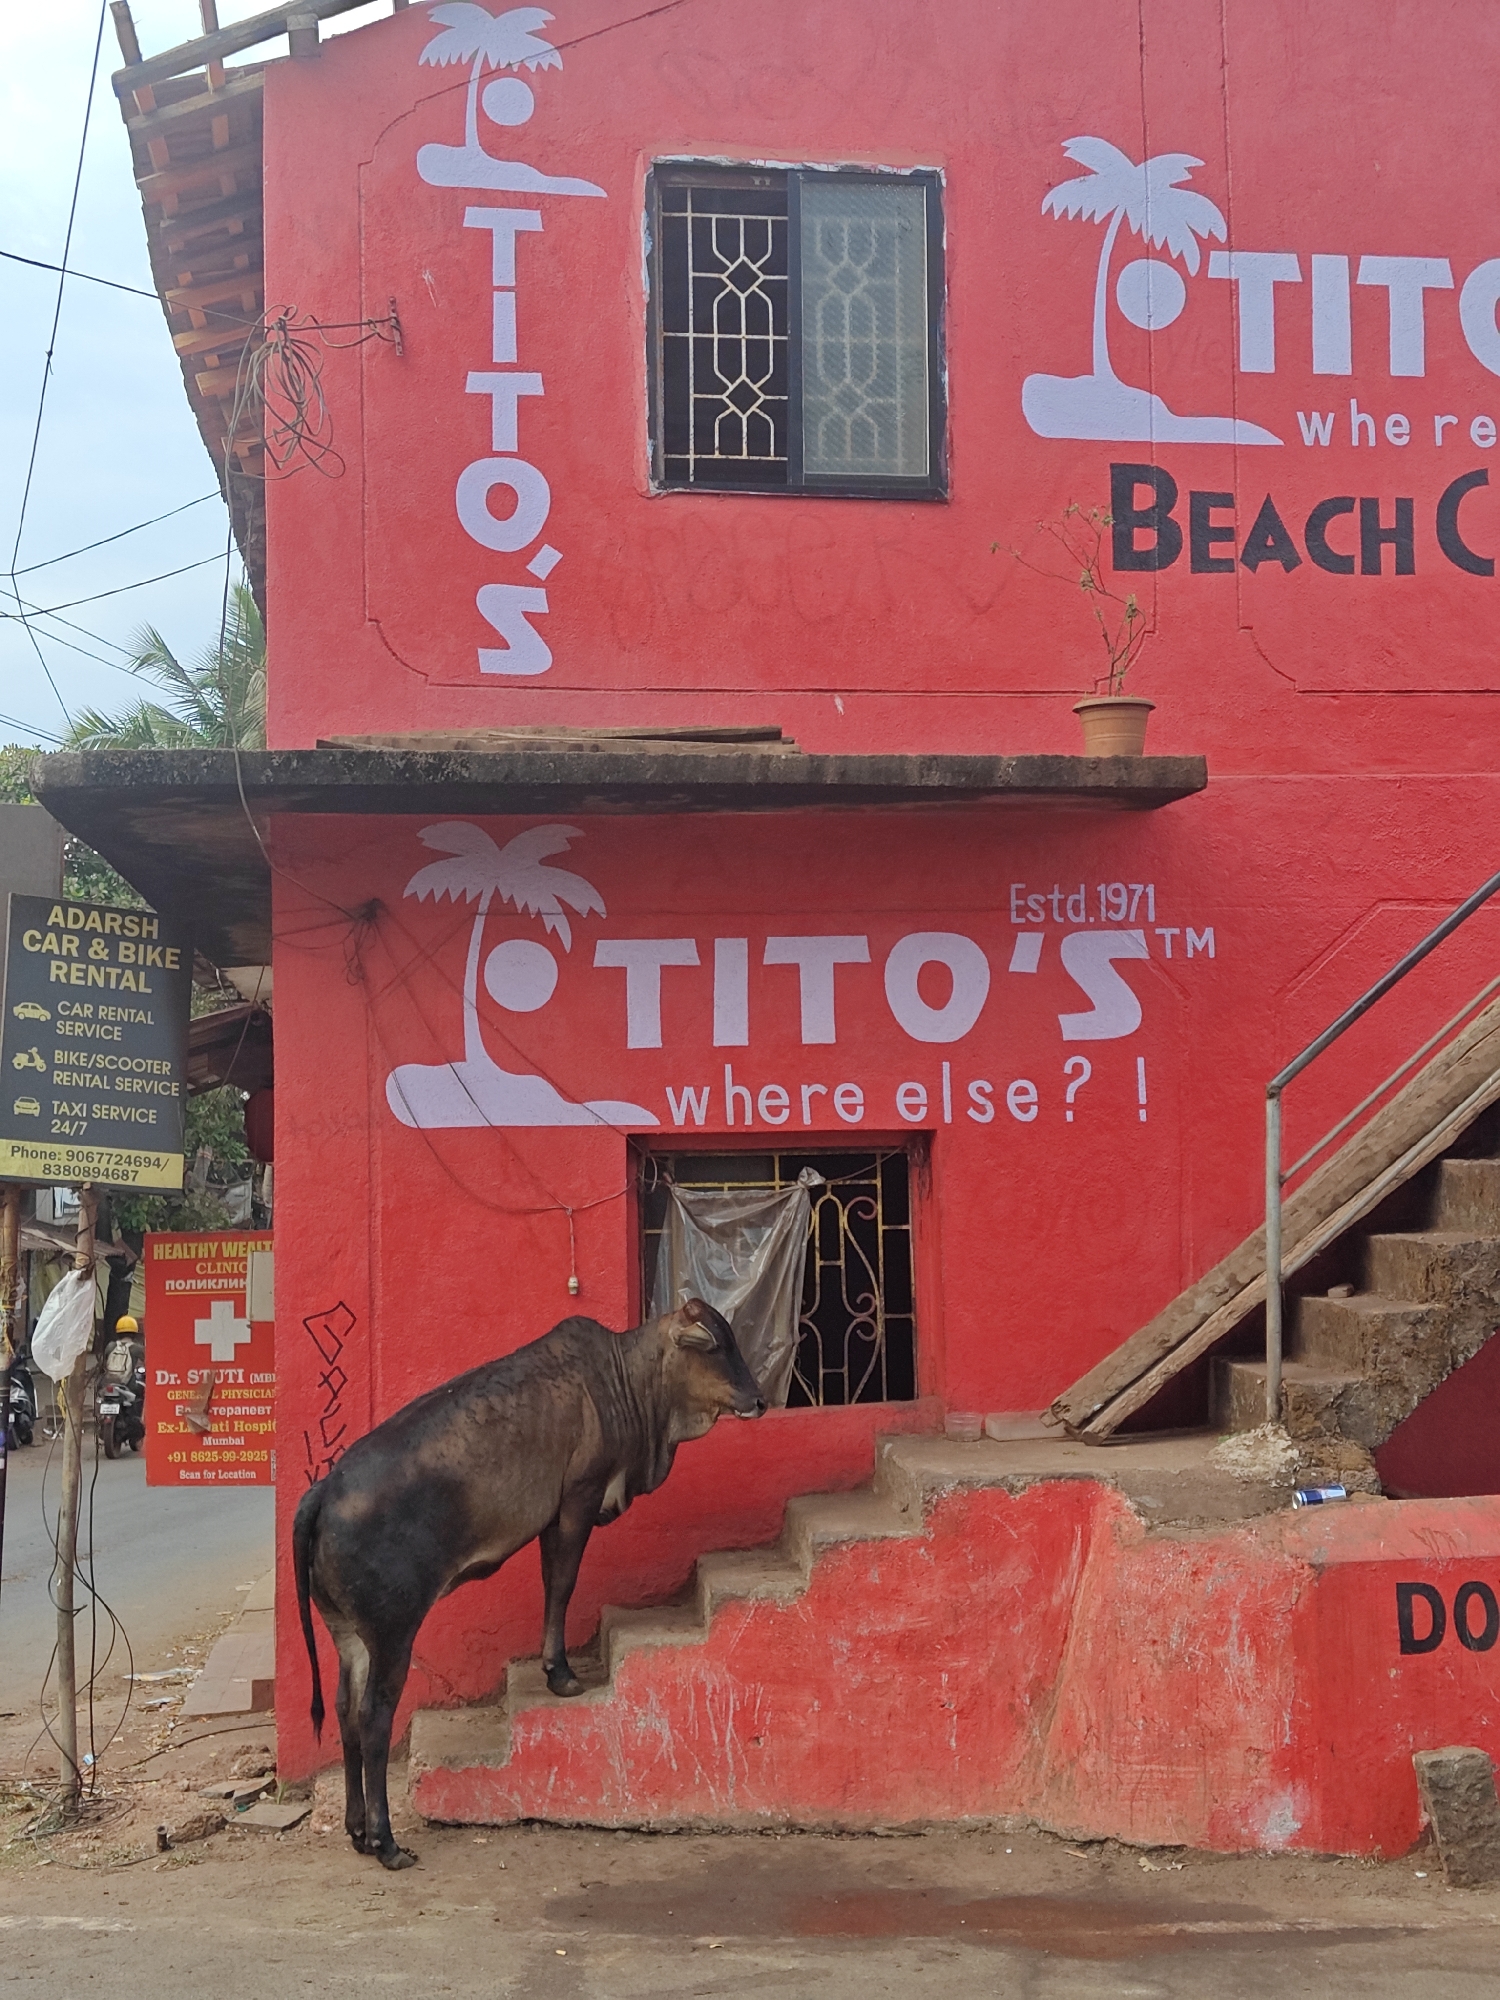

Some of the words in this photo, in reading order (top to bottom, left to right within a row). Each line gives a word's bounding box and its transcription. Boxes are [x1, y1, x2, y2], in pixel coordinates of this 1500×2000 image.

[1296, 398, 1497, 448] where
[455, 206, 563, 675] TITO'S
[1110, 463, 1416, 575] BEACH
[1010, 883, 1156, 923] Estd.1971
[47, 905, 159, 940] ADARSH
[22, 929, 80, 957] CAR
[88, 938, 109, 960] &
[118, 941, 181, 970] BIKE
[50, 960, 153, 994] RENTAL
[592, 928, 1151, 1049] TITO'S
[57, 1001, 93, 1018] CAR
[98, 1005, 154, 1025] RENTAL
[56, 1020, 122, 1041] SERVICE
[54, 1050, 171, 1075] BIKE/SCOOTER
[53, 1071, 110, 1089] RENTAL
[115, 1077, 179, 1097] SERVICE
[665, 1063, 865, 1127] where
[52, 1100, 87, 1117] TAXI
[92, 1104, 157, 1124] SERVICE
[51, 1119, 87, 1136] 24/7
[11, 1145, 62, 1162] Phone:
[65, 1150, 170, 1172] 9067724694/
[42, 1164, 139, 1182] 8380894687
[153, 1242, 218, 1260] HEALTHY
[155, 1369, 181, 1385] Dr.
[203, 1436, 245, 1446] Mumbai
[167, 1451, 187, 1463] +91
[190, 1450, 268, 1462] 8625-99-2925
[179, 1469, 200, 1480] Scan
[203, 1469, 216, 1479] for
[218, 1469, 256, 1480] Location
